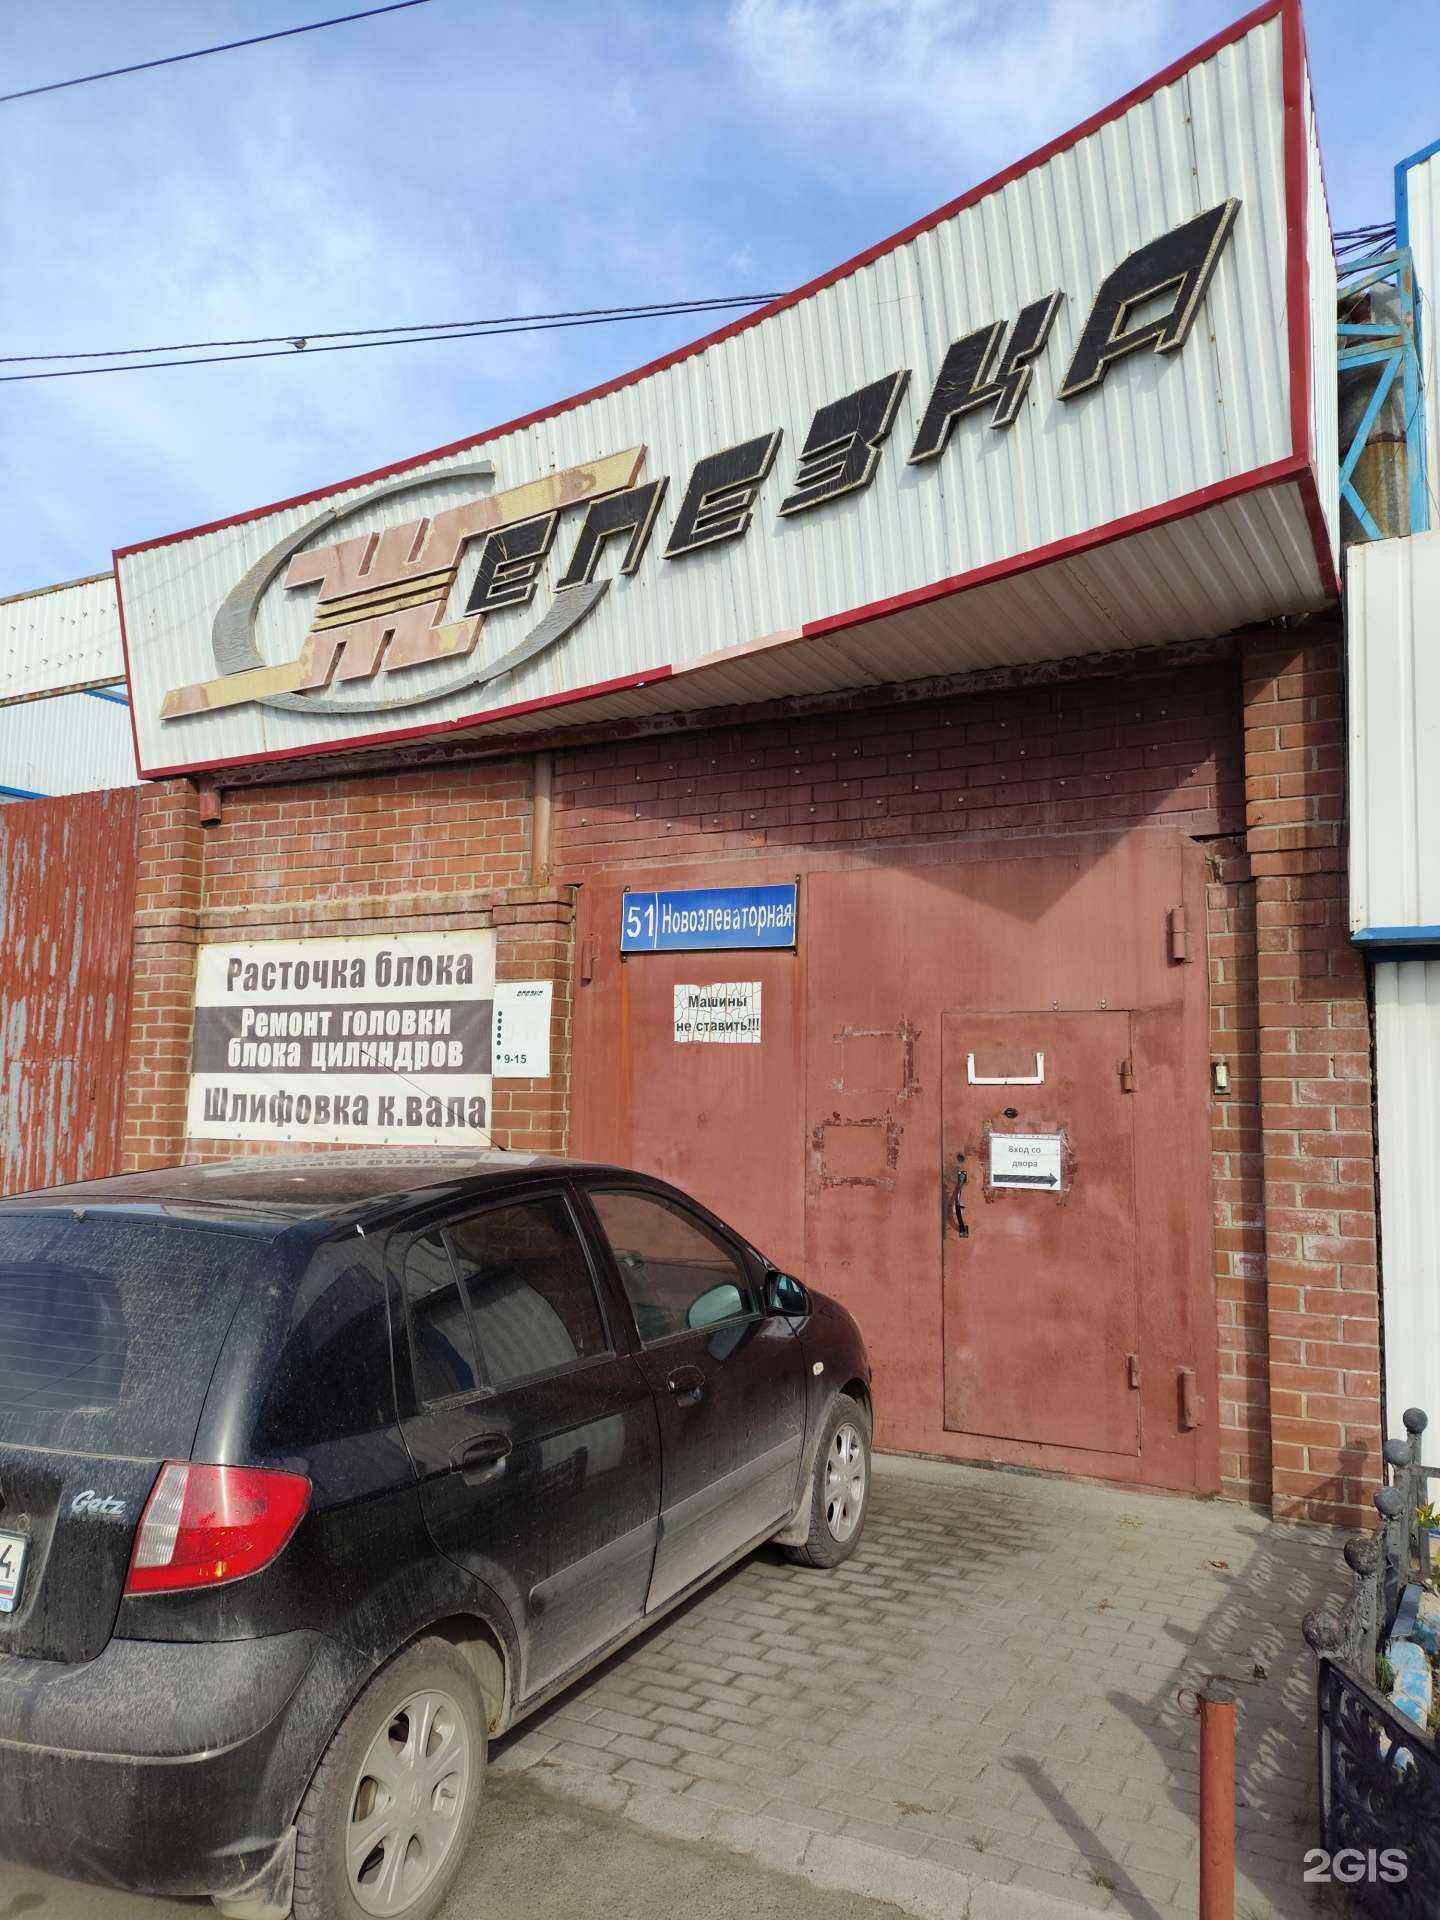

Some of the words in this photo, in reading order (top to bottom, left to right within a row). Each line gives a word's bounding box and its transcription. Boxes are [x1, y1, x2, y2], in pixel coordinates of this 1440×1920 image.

[626, 905, 654, 938] 51
[661, 902, 793, 937] Новоэлеваторная
[226, 957, 366, 992] Расточка
[374, 950, 474, 987] блока
[688, 995, 747, 1008] Машины
[240, 1007, 333, 1038] Ремонт
[341, 1008, 451, 1036] головки
[676, 1023, 692, 1033] не
[695, 1018, 760, 1033] ставить!!!
[227, 1038, 301, 1068] блока
[311, 1039, 463, 1072] цилиндров
[203, 1086, 369, 1128] Шлифовка
[1008, 1145, 1029, 1154] Вход
[1031, 1146, 1042, 1154] со
[1011, 1160, 1038, 1168] двора
[71, 1489, 127, 1515] Getz
